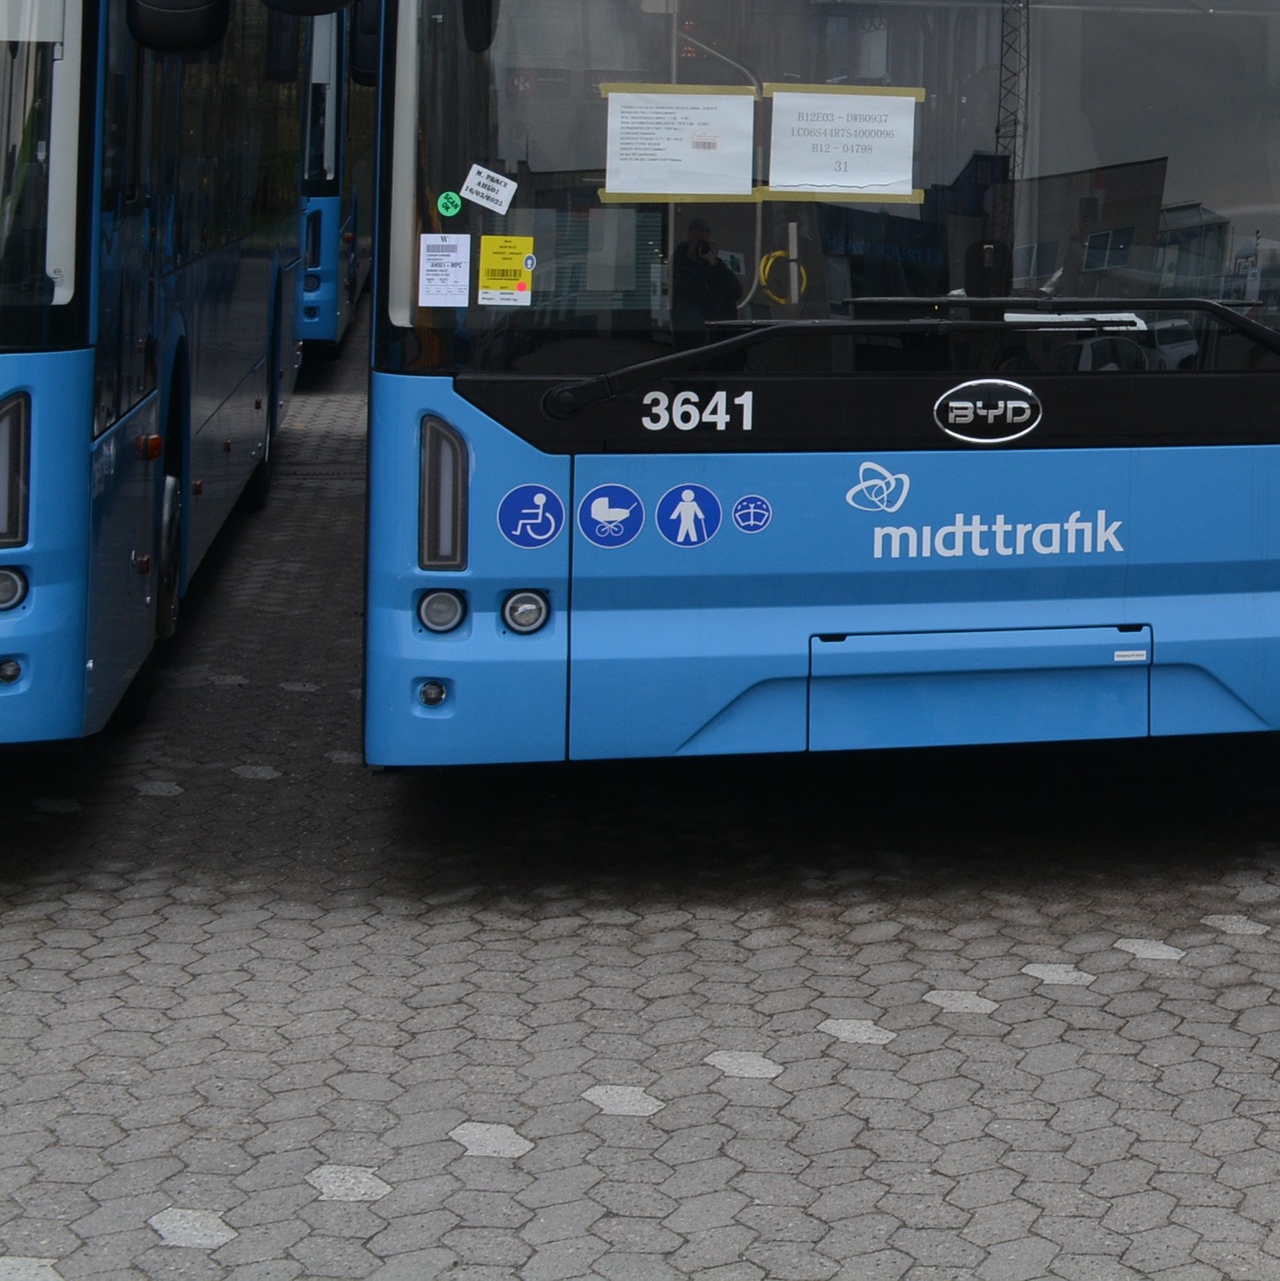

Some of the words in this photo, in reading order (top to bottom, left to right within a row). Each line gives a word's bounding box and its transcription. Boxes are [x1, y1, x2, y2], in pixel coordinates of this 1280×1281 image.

[812, 143, 830, 153] B12
[834, 161, 848, 172] 31
[442, 202, 451, 212] OK
[443, 193, 460, 209] SCAN
[640, 390, 754, 432] 3641
[947, 401, 1032, 425] BYD
[873, 509, 1125, 559] midttrafik
